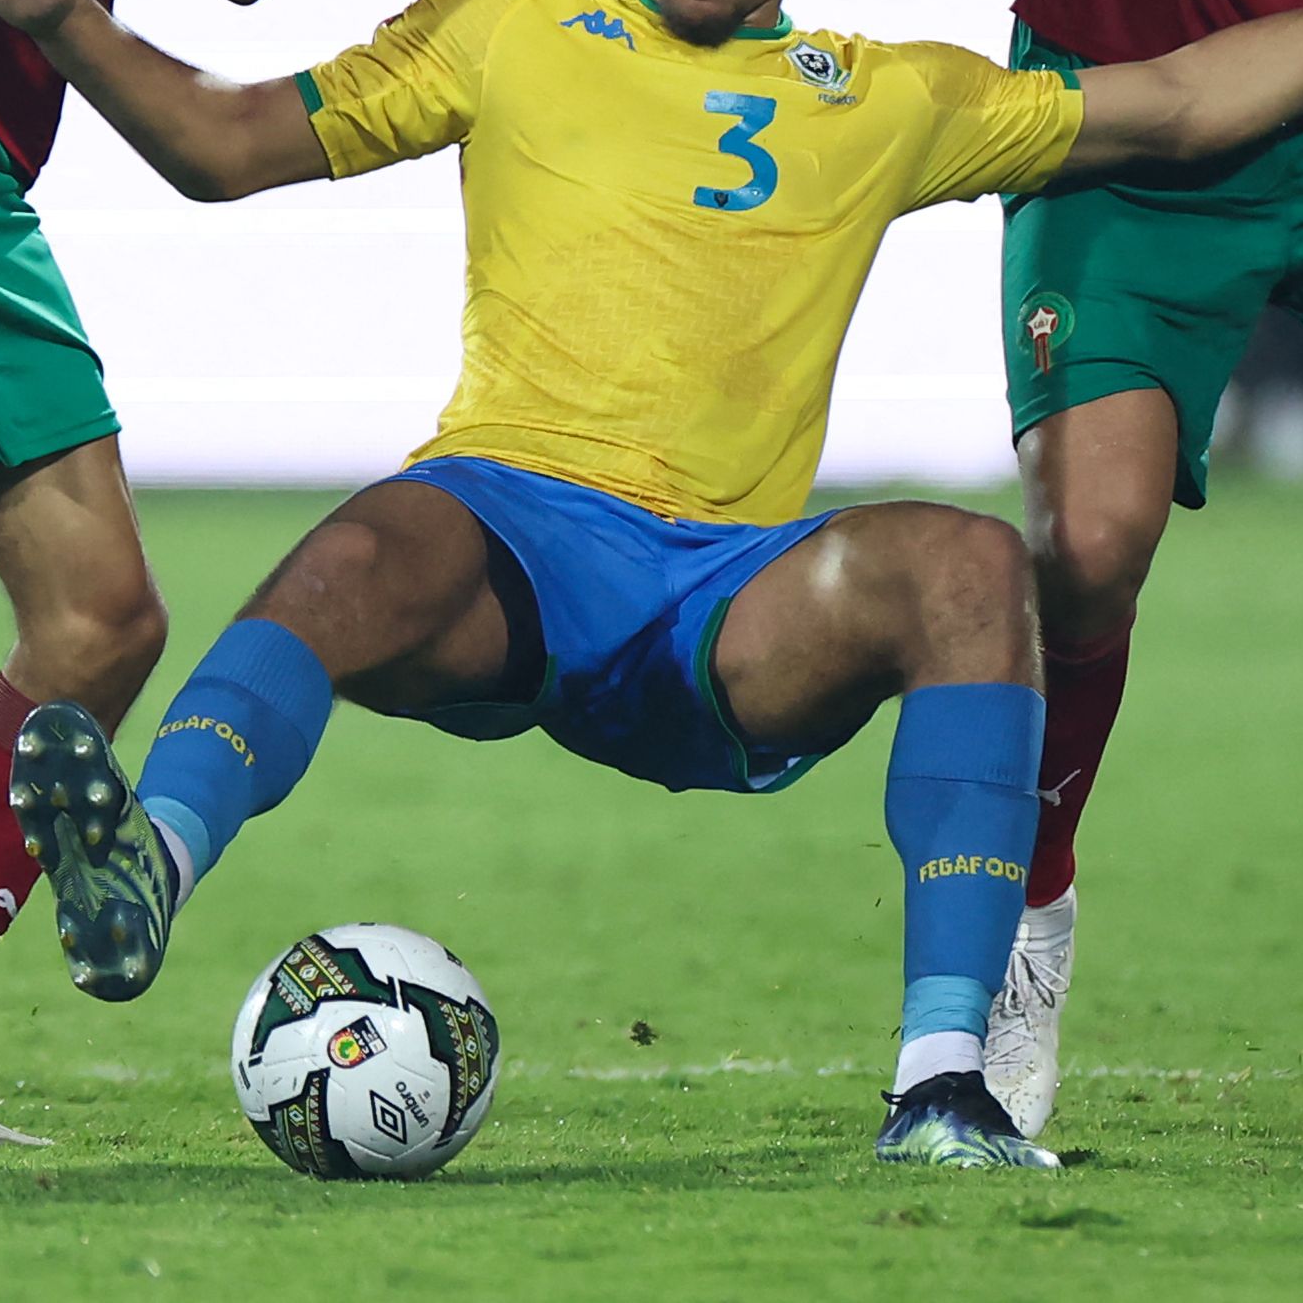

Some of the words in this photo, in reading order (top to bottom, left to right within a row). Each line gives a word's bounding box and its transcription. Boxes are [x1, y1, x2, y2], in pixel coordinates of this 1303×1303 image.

[693, 90, 778, 211] 3
[919, 854, 1026, 888] FEGAFOOT
[395, 1081, 430, 1129] umbro
